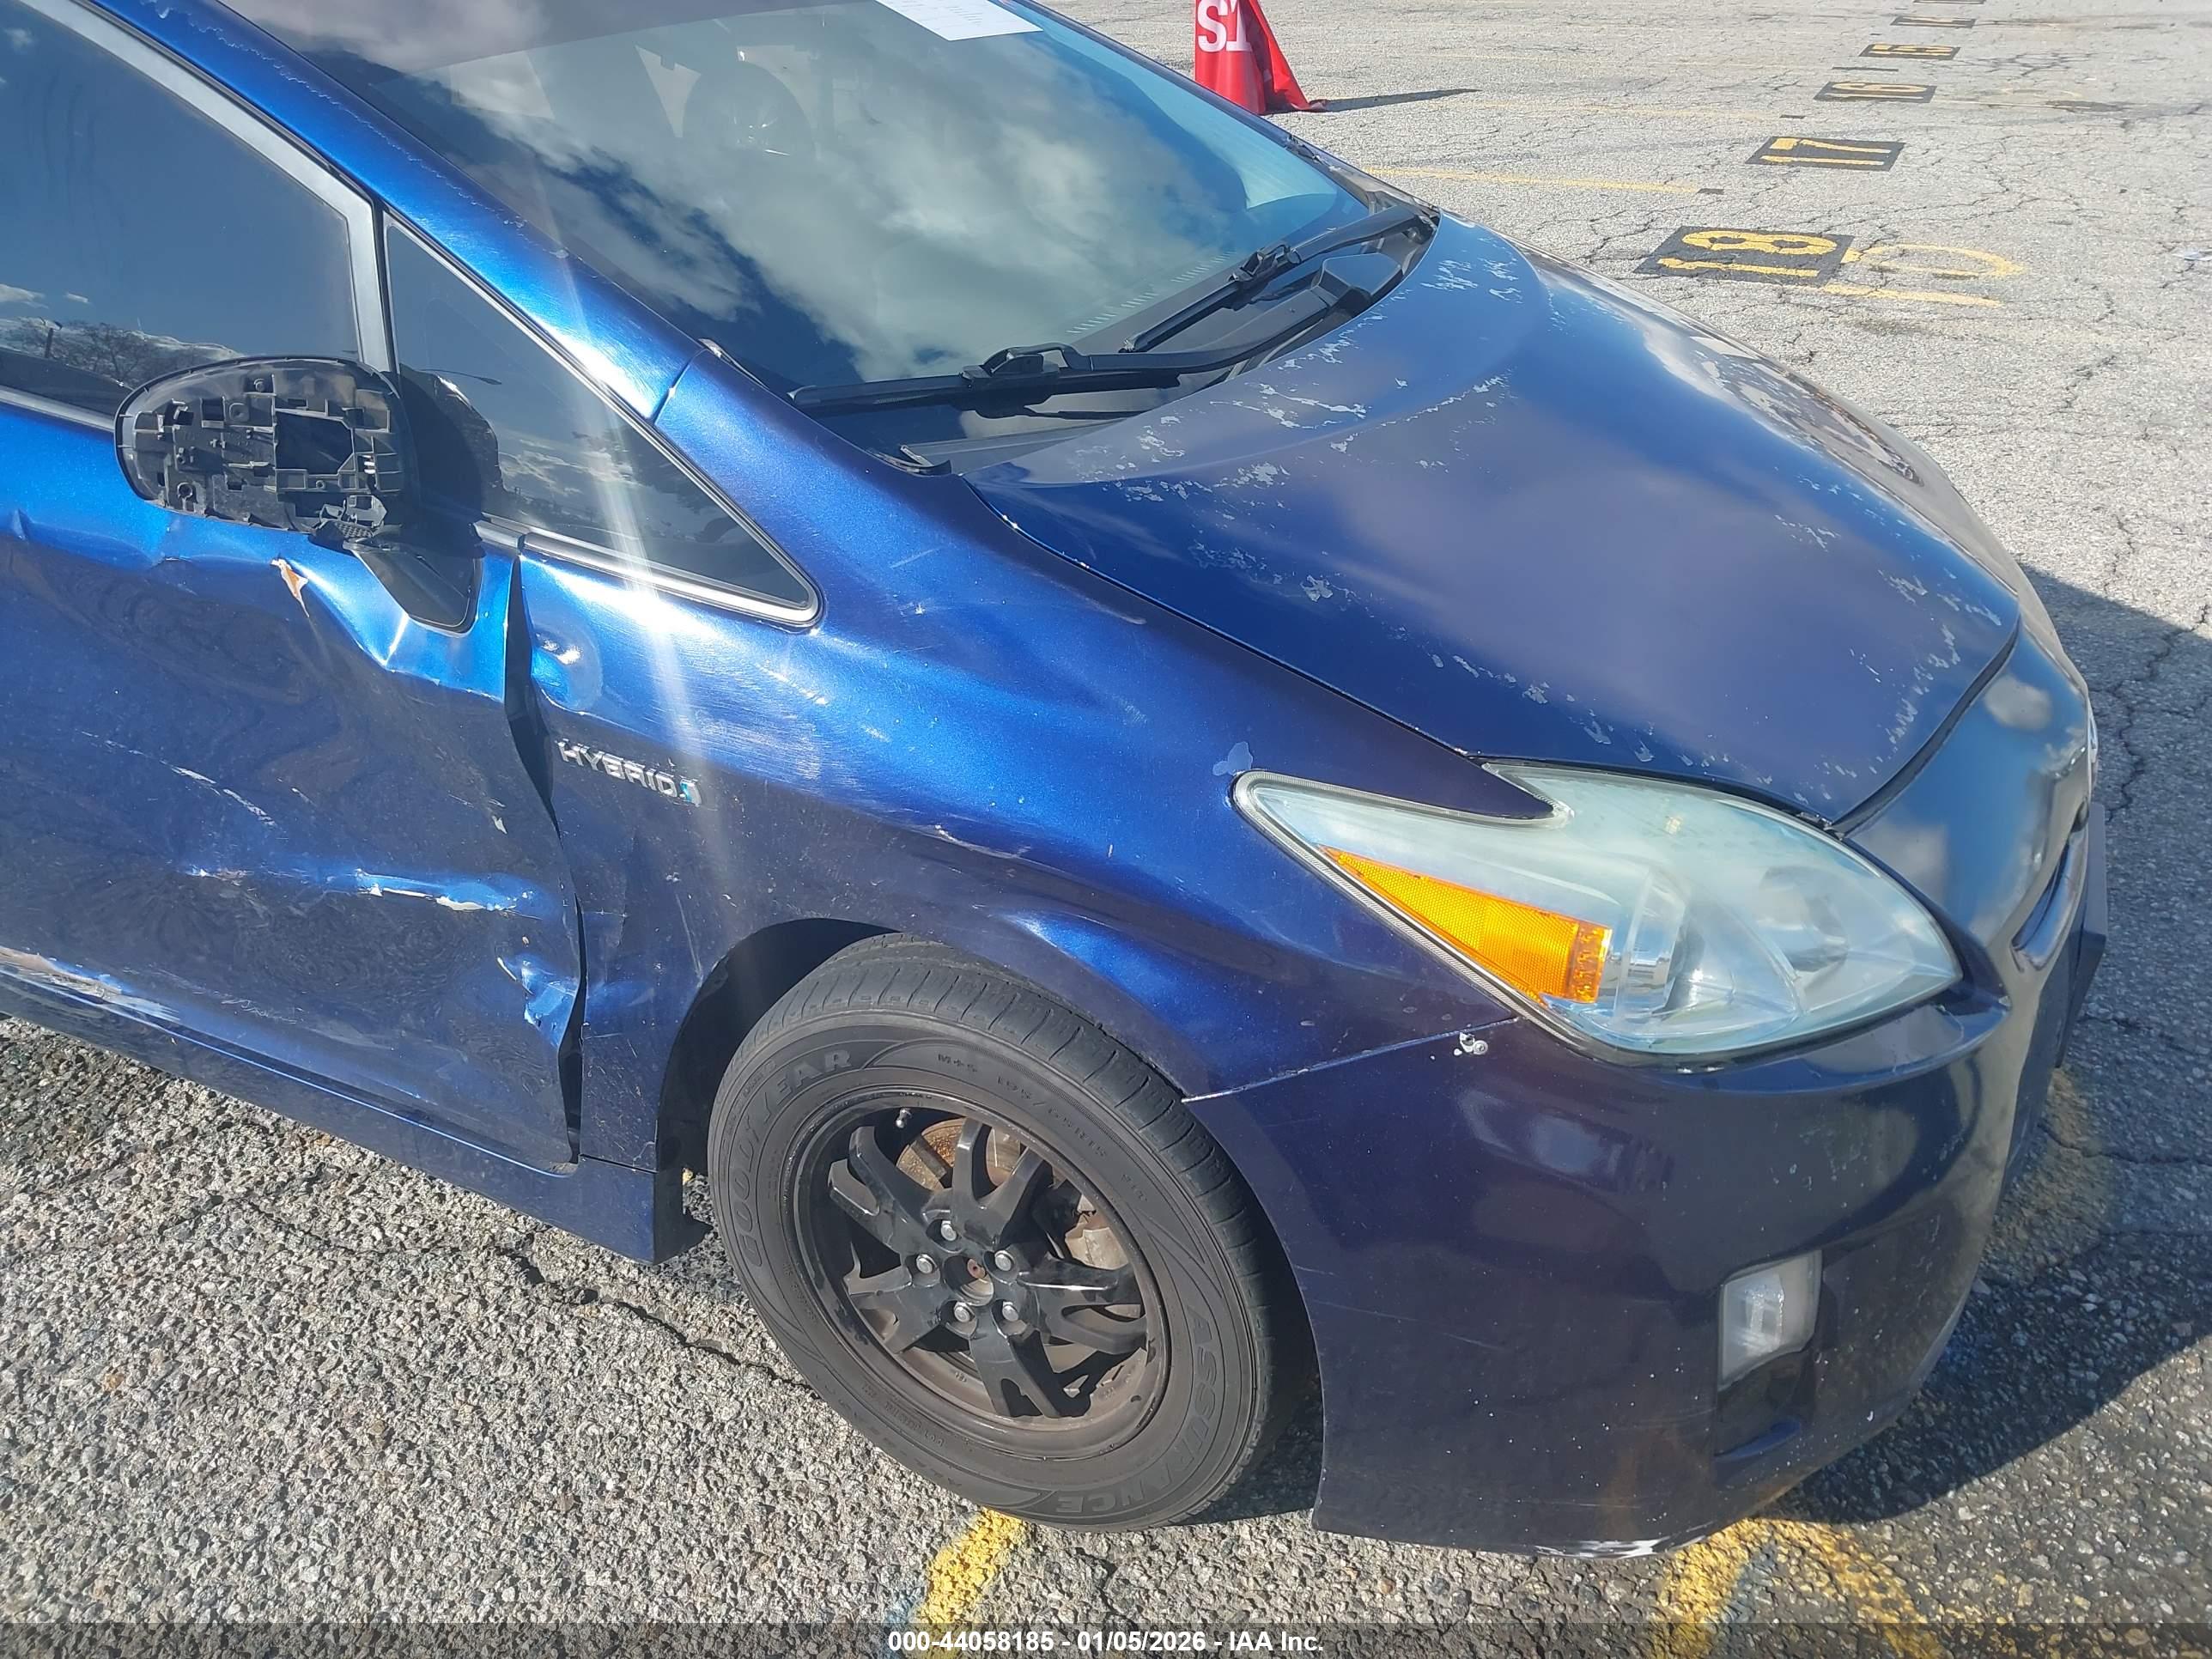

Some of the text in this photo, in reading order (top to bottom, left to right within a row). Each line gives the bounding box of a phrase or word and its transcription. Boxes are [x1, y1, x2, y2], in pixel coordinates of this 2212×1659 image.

[1867, 44, 1954, 57] 15
[1824, 82, 1929, 100] 16
[1760, 137, 1892, 167] 17
[1657, 229, 1838, 278] 18
[555, 738, 678, 799] HYBRID
